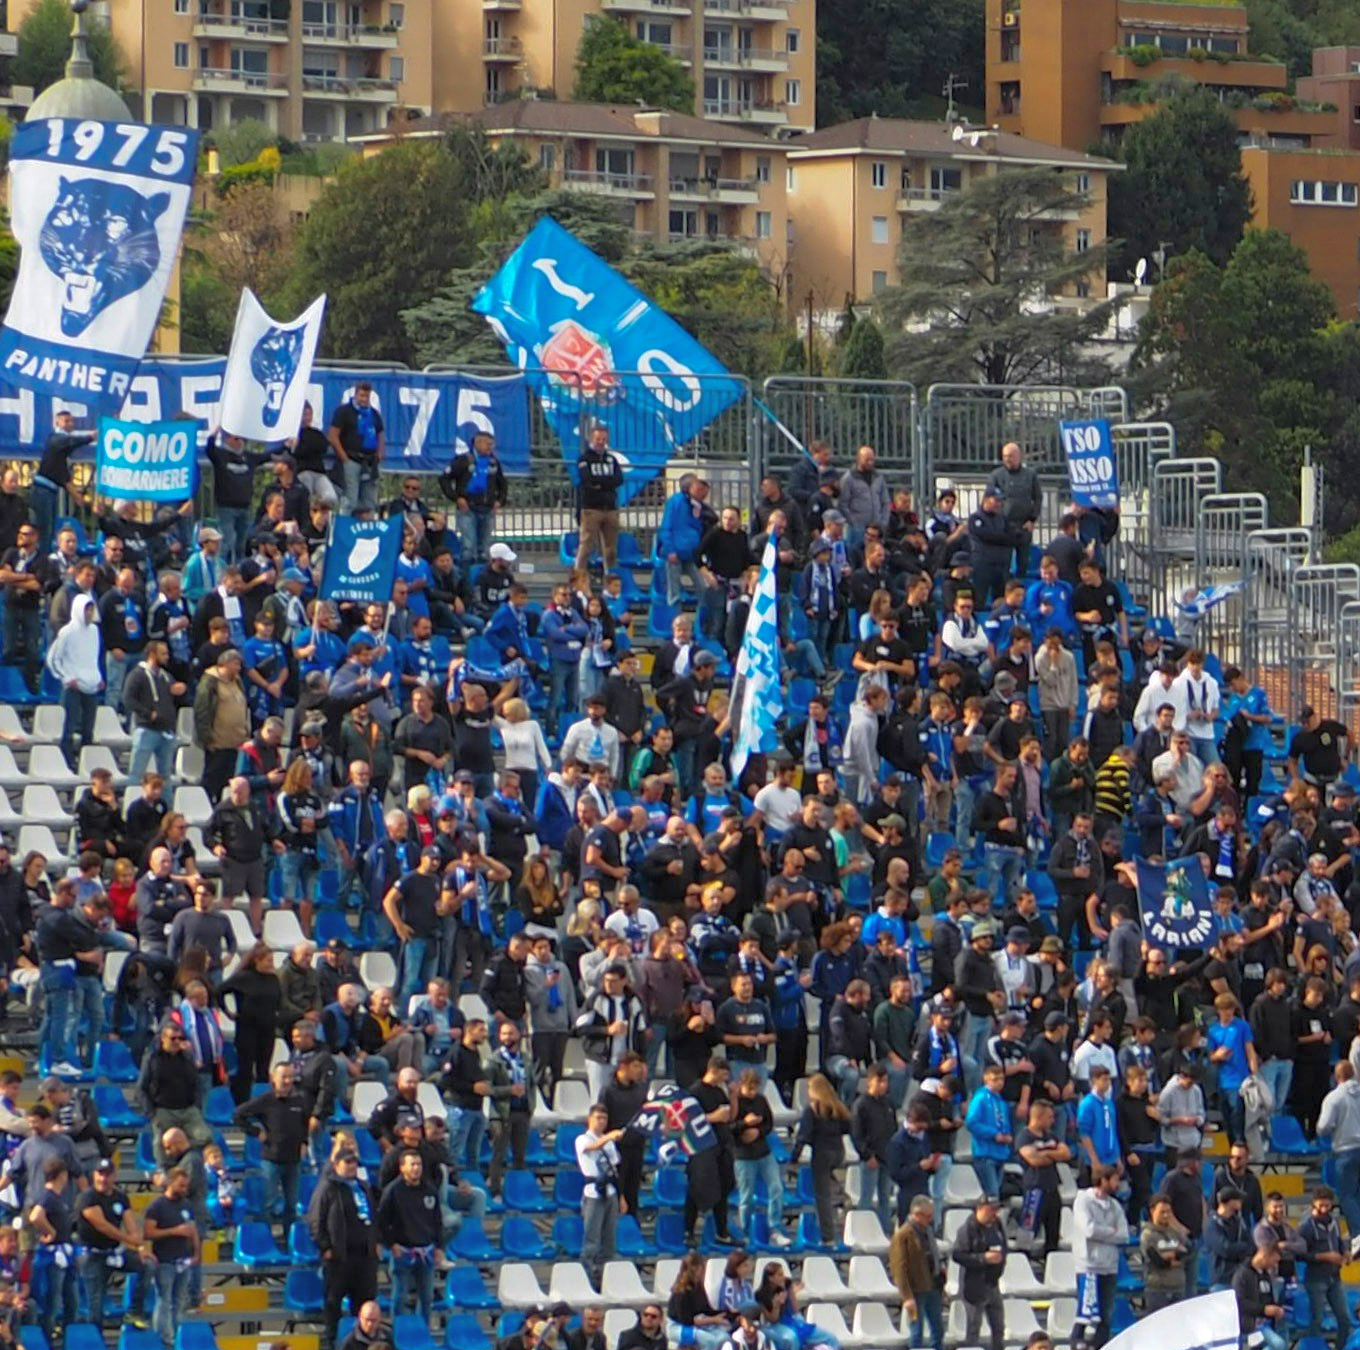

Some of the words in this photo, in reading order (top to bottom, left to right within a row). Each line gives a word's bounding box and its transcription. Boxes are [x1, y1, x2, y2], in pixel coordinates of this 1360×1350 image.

[46, 118, 188, 176] 1975
[103, 428, 188, 464] COMO
[1143, 910, 1212, 946] LARIANI
